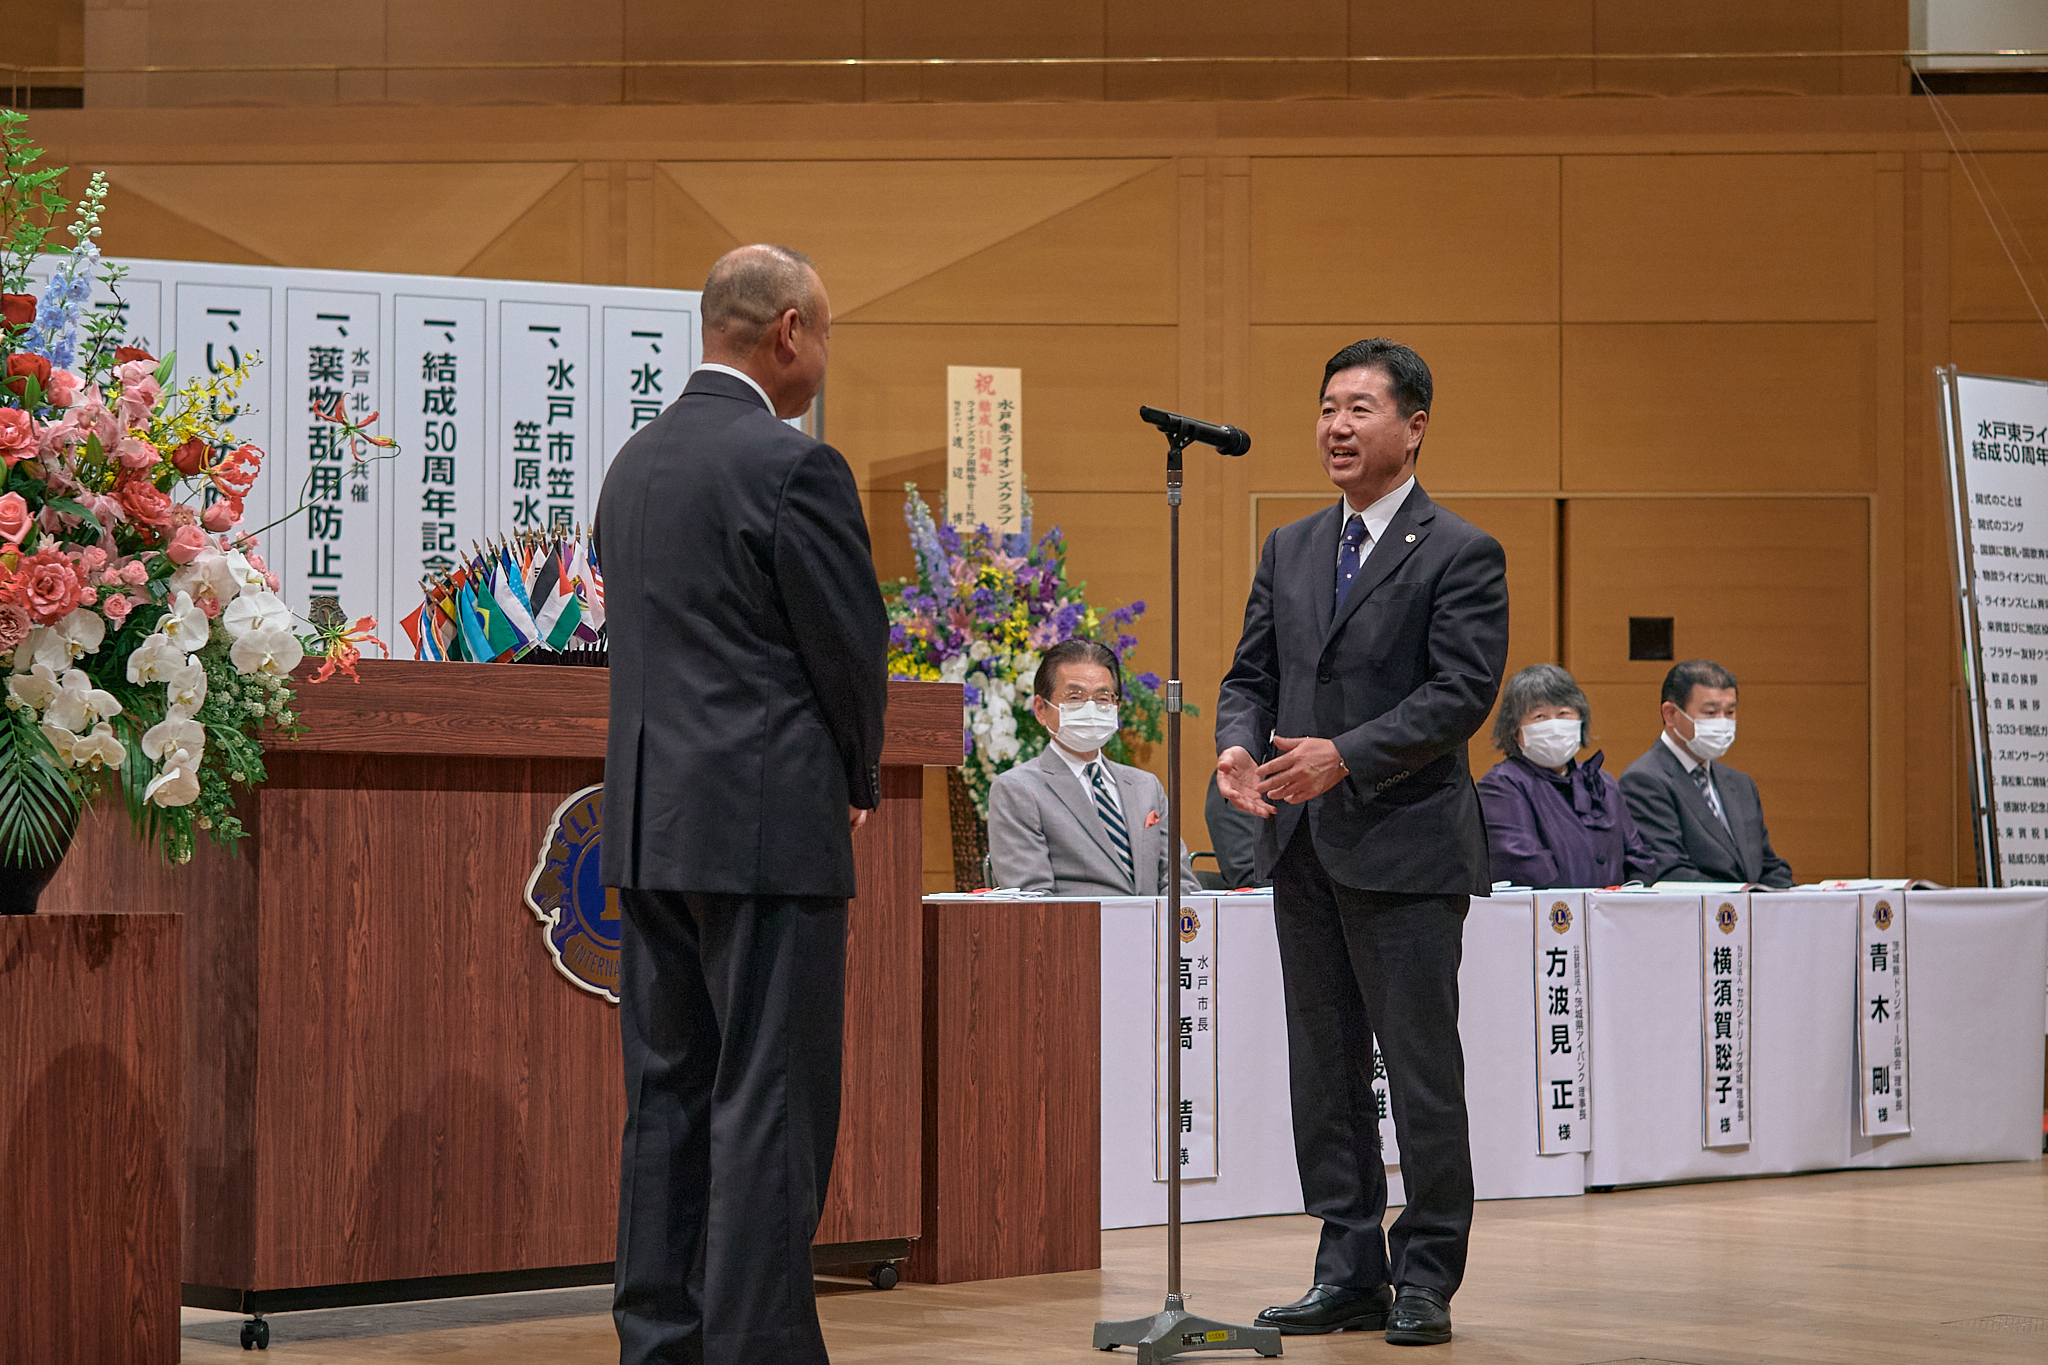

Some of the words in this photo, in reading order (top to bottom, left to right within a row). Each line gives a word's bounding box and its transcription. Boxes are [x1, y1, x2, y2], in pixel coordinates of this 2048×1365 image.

[975, 373, 996, 396] 祝
[529, 325, 575, 548] 一、水戸市笠原
[997, 399, 1015, 526] 水戸東ライオンズクラブ
[1972, 440, 2048, 467] 結成50周年
[1978, 419, 2048, 444] 水戸東ライ
[513, 421, 542, 550] 笠原水
[1197, 954, 1209, 1032] 水戸市長
[1546, 946, 1572, 1055] 方波見
[1713, 946, 1732, 1104] 横須賀聡子
[1558, 1123, 1571, 1141] 様
[1720, 1117, 1731, 1134] 様
